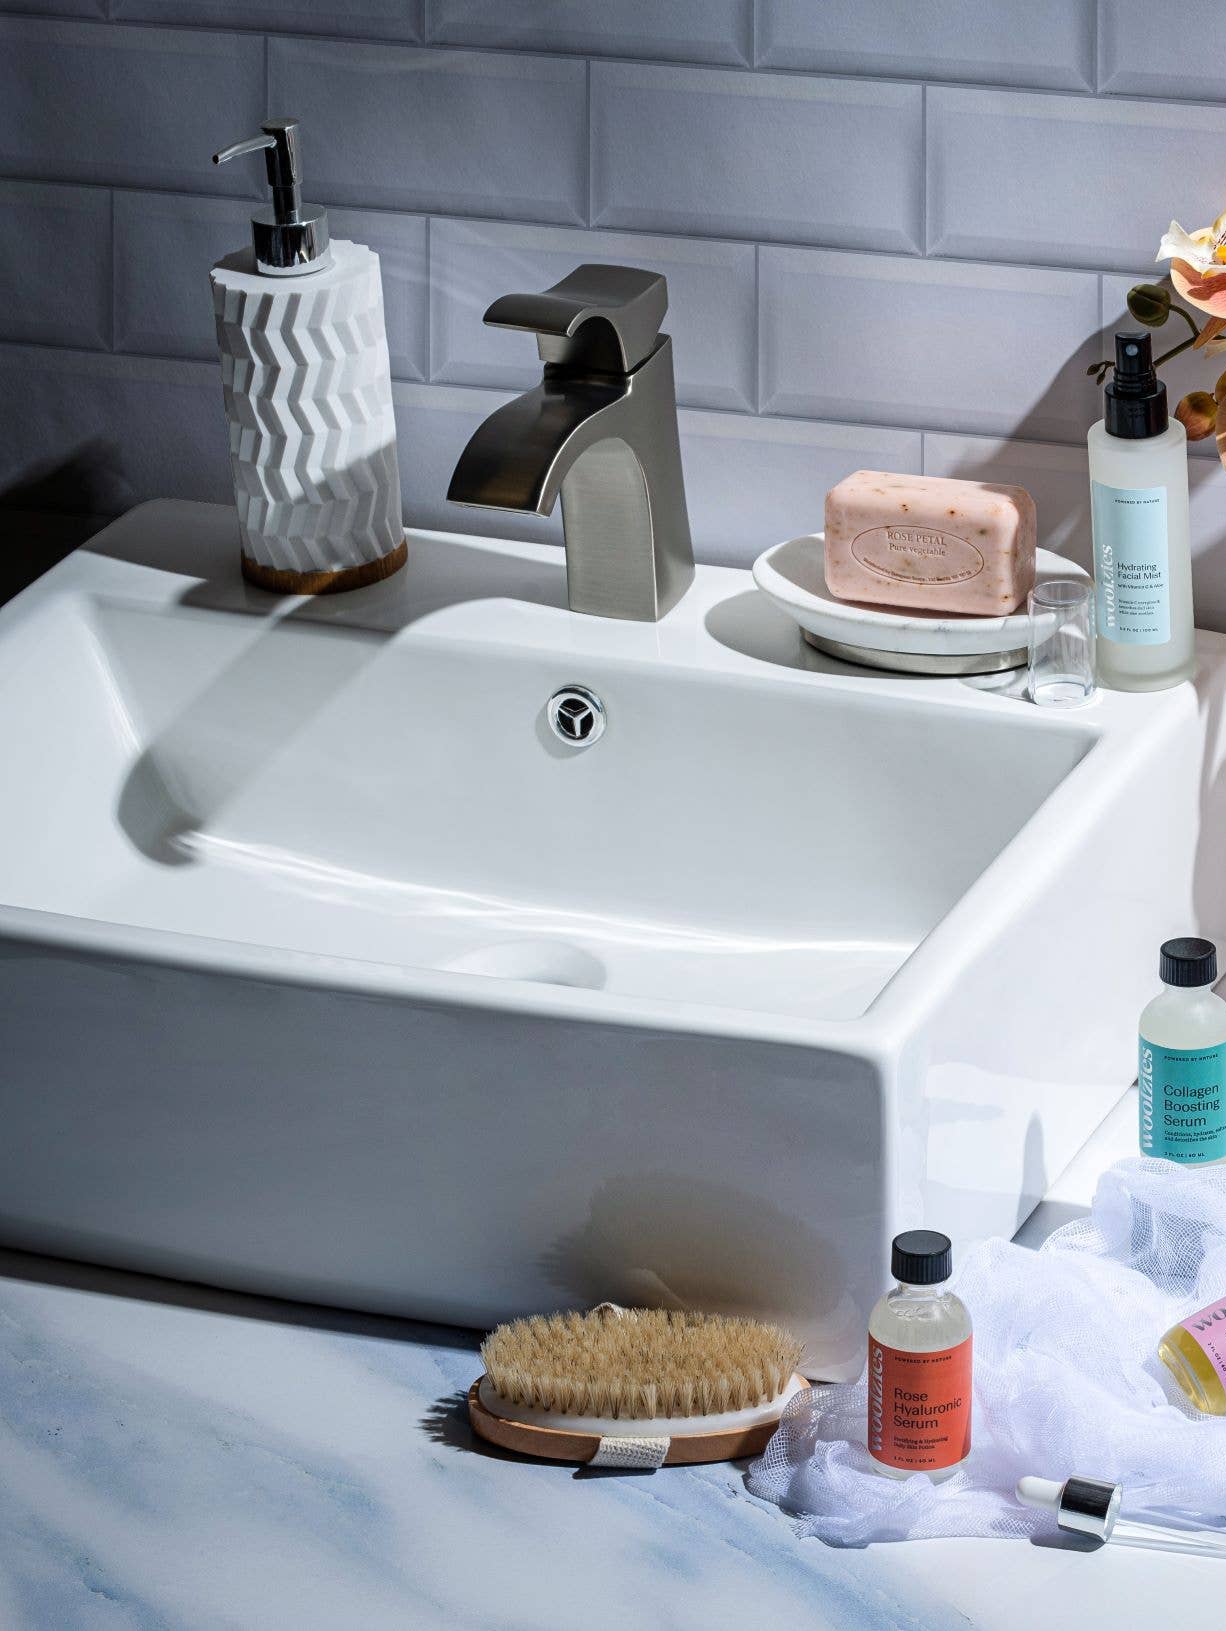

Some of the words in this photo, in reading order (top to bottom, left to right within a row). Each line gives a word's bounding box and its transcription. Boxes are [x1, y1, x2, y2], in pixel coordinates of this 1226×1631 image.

[887, 530, 913, 542] ROSE
[916, 535, 947, 546] PETAL
[889, 542, 907, 551] Pure
[909, 546, 946, 557] vegetable
[1117, 561, 1157, 571] Hydrating
[1118, 571, 1141, 580] Facial
[1143, 572, 1161, 580] Mist
[1143, 1046, 1153, 1148] woolzies
[1163, 1084, 1219, 1099] Collagen
[1164, 1099, 1220, 1112] Boosting
[1164, 1114, 1206, 1127] Serum
[894, 1388, 928, 1402] Rose
[894, 1398, 962, 1416] Hyaluronic
[893, 1415, 938, 1429] Serum
